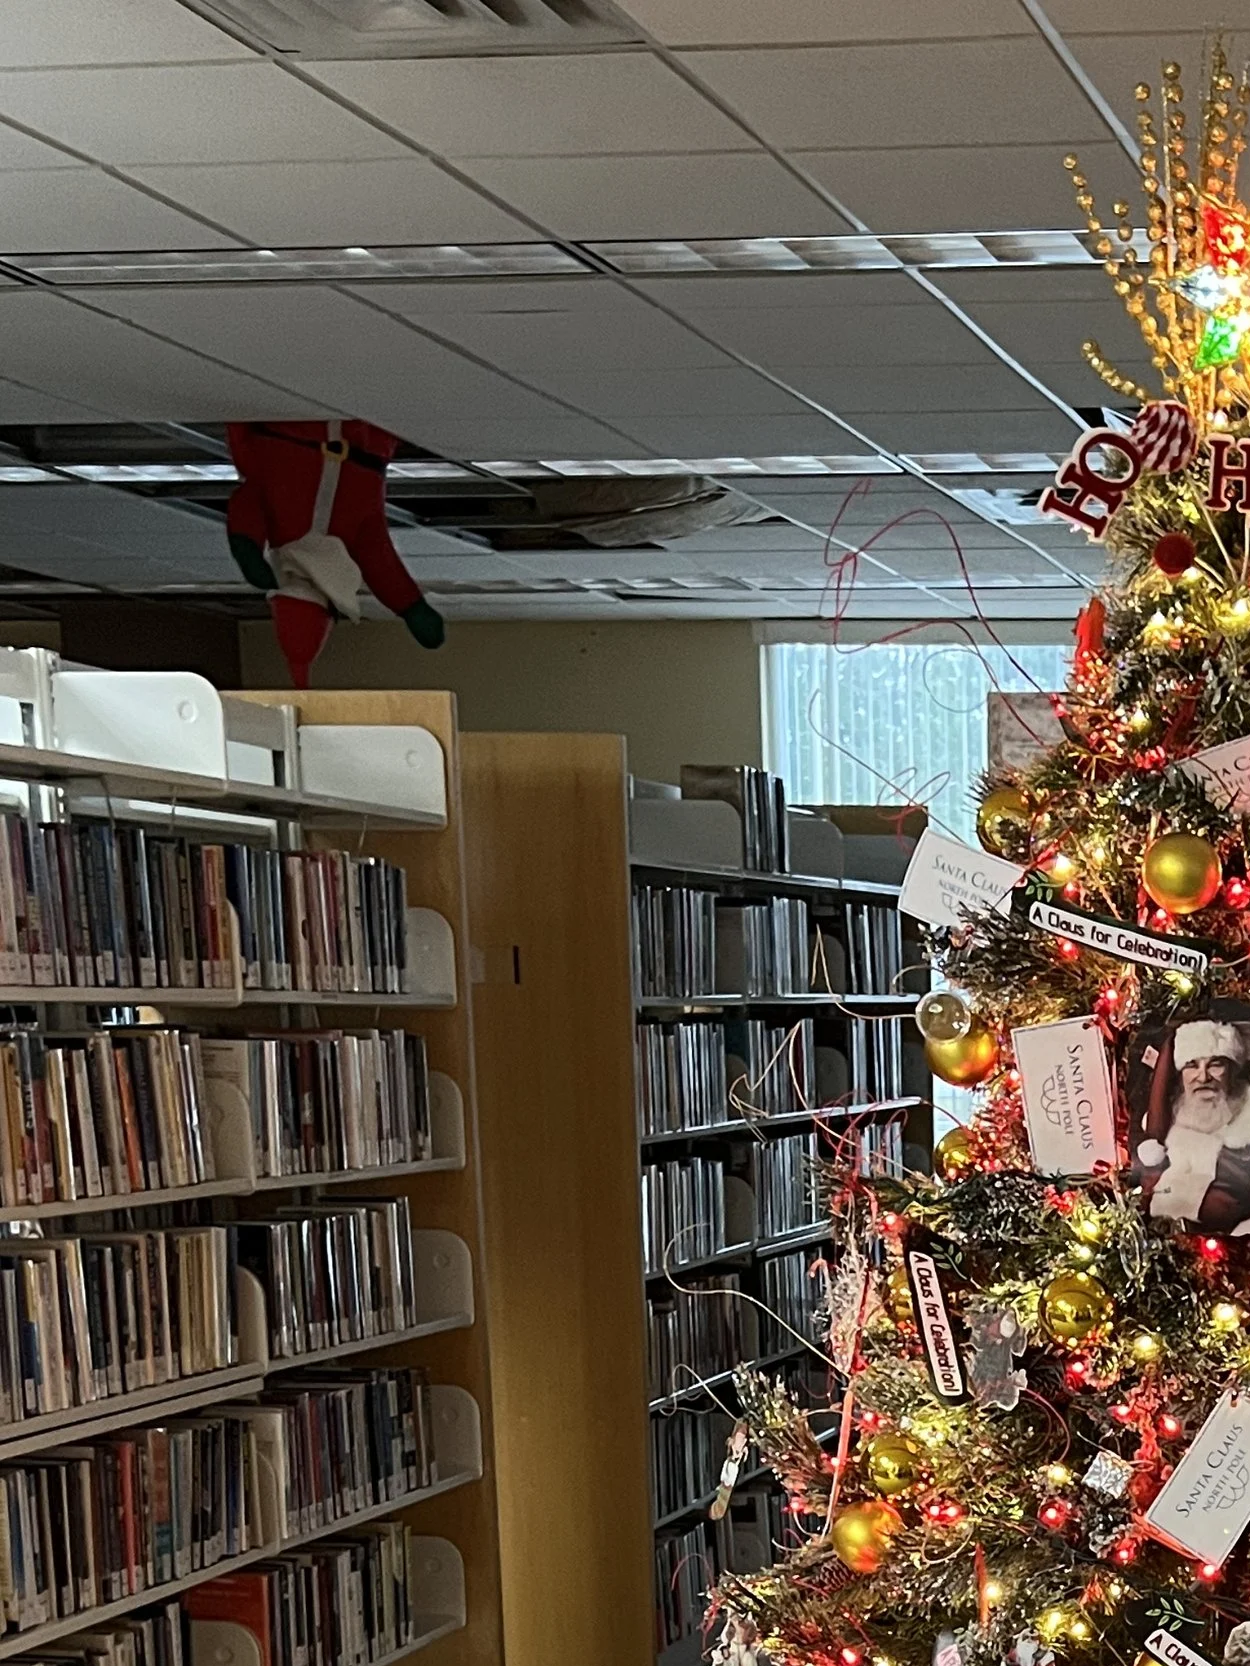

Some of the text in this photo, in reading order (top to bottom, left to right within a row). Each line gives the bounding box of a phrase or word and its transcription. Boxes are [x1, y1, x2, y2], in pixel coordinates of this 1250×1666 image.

[1037, 428, 1142, 540] HO
[933, 854, 970, 885] SANTA
[1032, 907, 1205, 972] A Claus for Celebration!
[1055, 1064, 1069, 1103] NORTH
[1067, 1044, 1095, 1150] SANTA CLAUS
[1176, 1424, 1243, 1518] SANTA CLAUS
[1202, 1449, 1247, 1512] NORTH POLE
[1149, 1634, 1163, 1649] A
